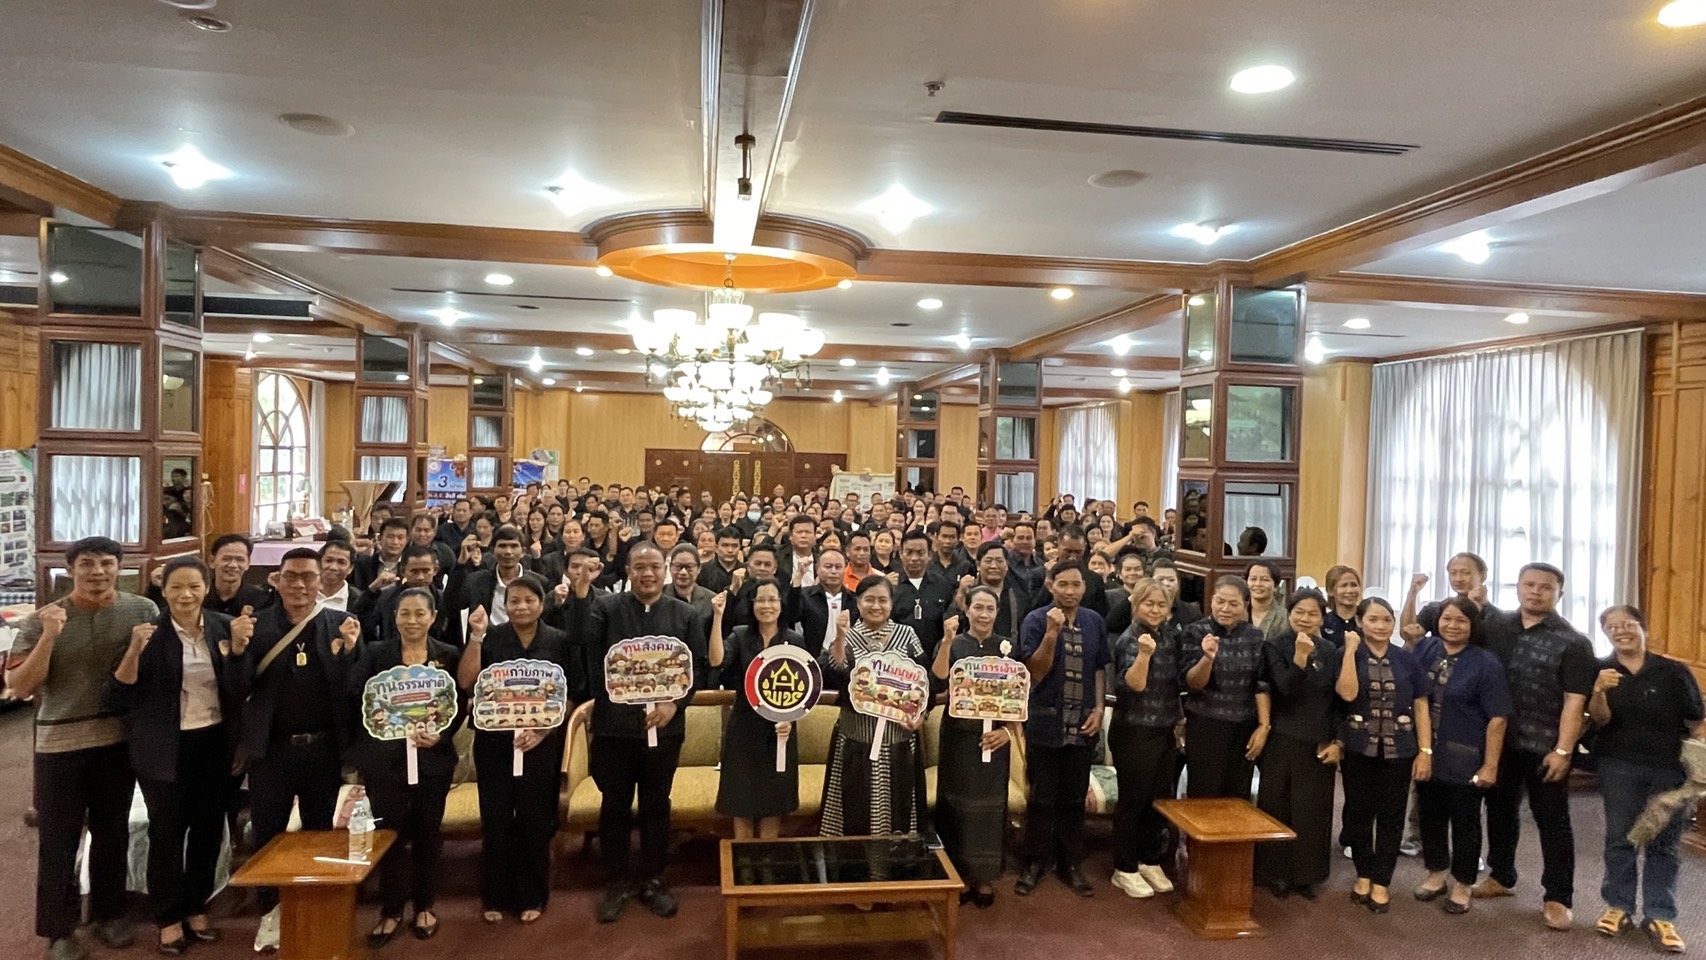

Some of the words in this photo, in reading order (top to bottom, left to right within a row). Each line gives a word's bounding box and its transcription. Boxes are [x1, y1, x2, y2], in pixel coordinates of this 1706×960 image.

[622, 641, 673, 656] ทุนสังคม
[871, 659, 921, 681] ทุนมนุษย์
[964, 662, 1017, 676] ทุนการเงิน
[373, 675, 445, 699] ทุนธรรมชาติ
